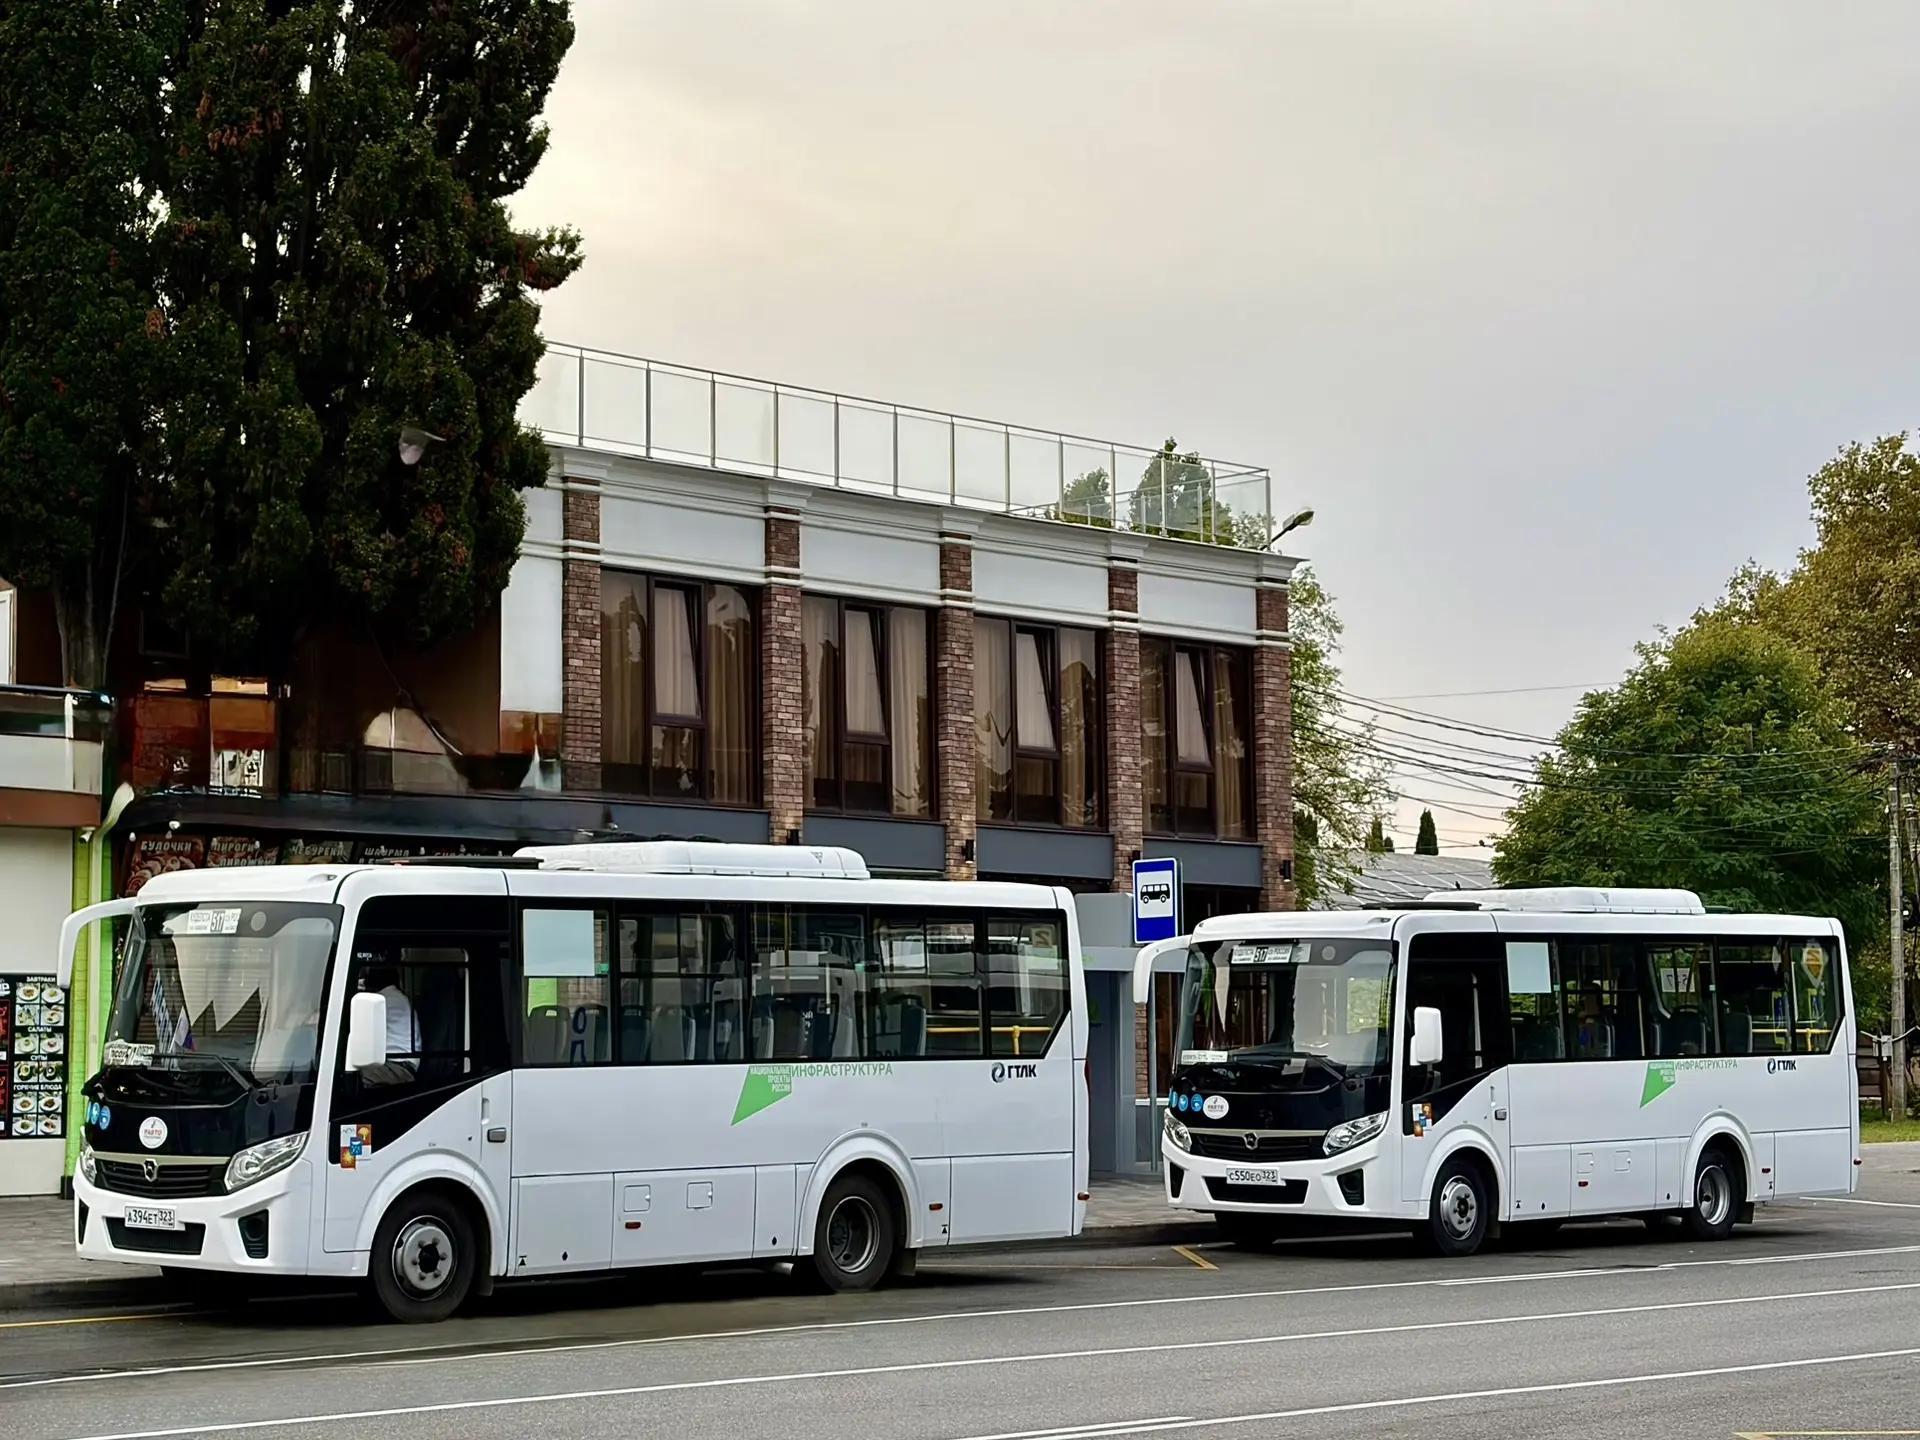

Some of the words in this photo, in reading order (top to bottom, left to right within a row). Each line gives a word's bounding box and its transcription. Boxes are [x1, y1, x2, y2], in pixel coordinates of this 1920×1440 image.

[141, 840, 192, 851] БУЛОЧКИ
[213, 842, 255, 852] ПИРОГИ
[211, 911, 225, 932] 517
[1254, 946, 1269, 962] 517
[791, 1063, 893, 1077] ИНФРАСТРУКТУРА
[1675, 1059, 1738, 1070] ИНФРАСТРУКТУРА
[1777, 1059, 1797, 1071] ГТЛК
[1007, 1064, 1037, 1079] ГТЛК
[1229, 1170, 1262, 1182] С550ЕО
[1262, 1170, 1277, 1180] 323
[127, 1209, 158, 1225] А394ЕТ
[159, 1210, 173, 1222] 323
